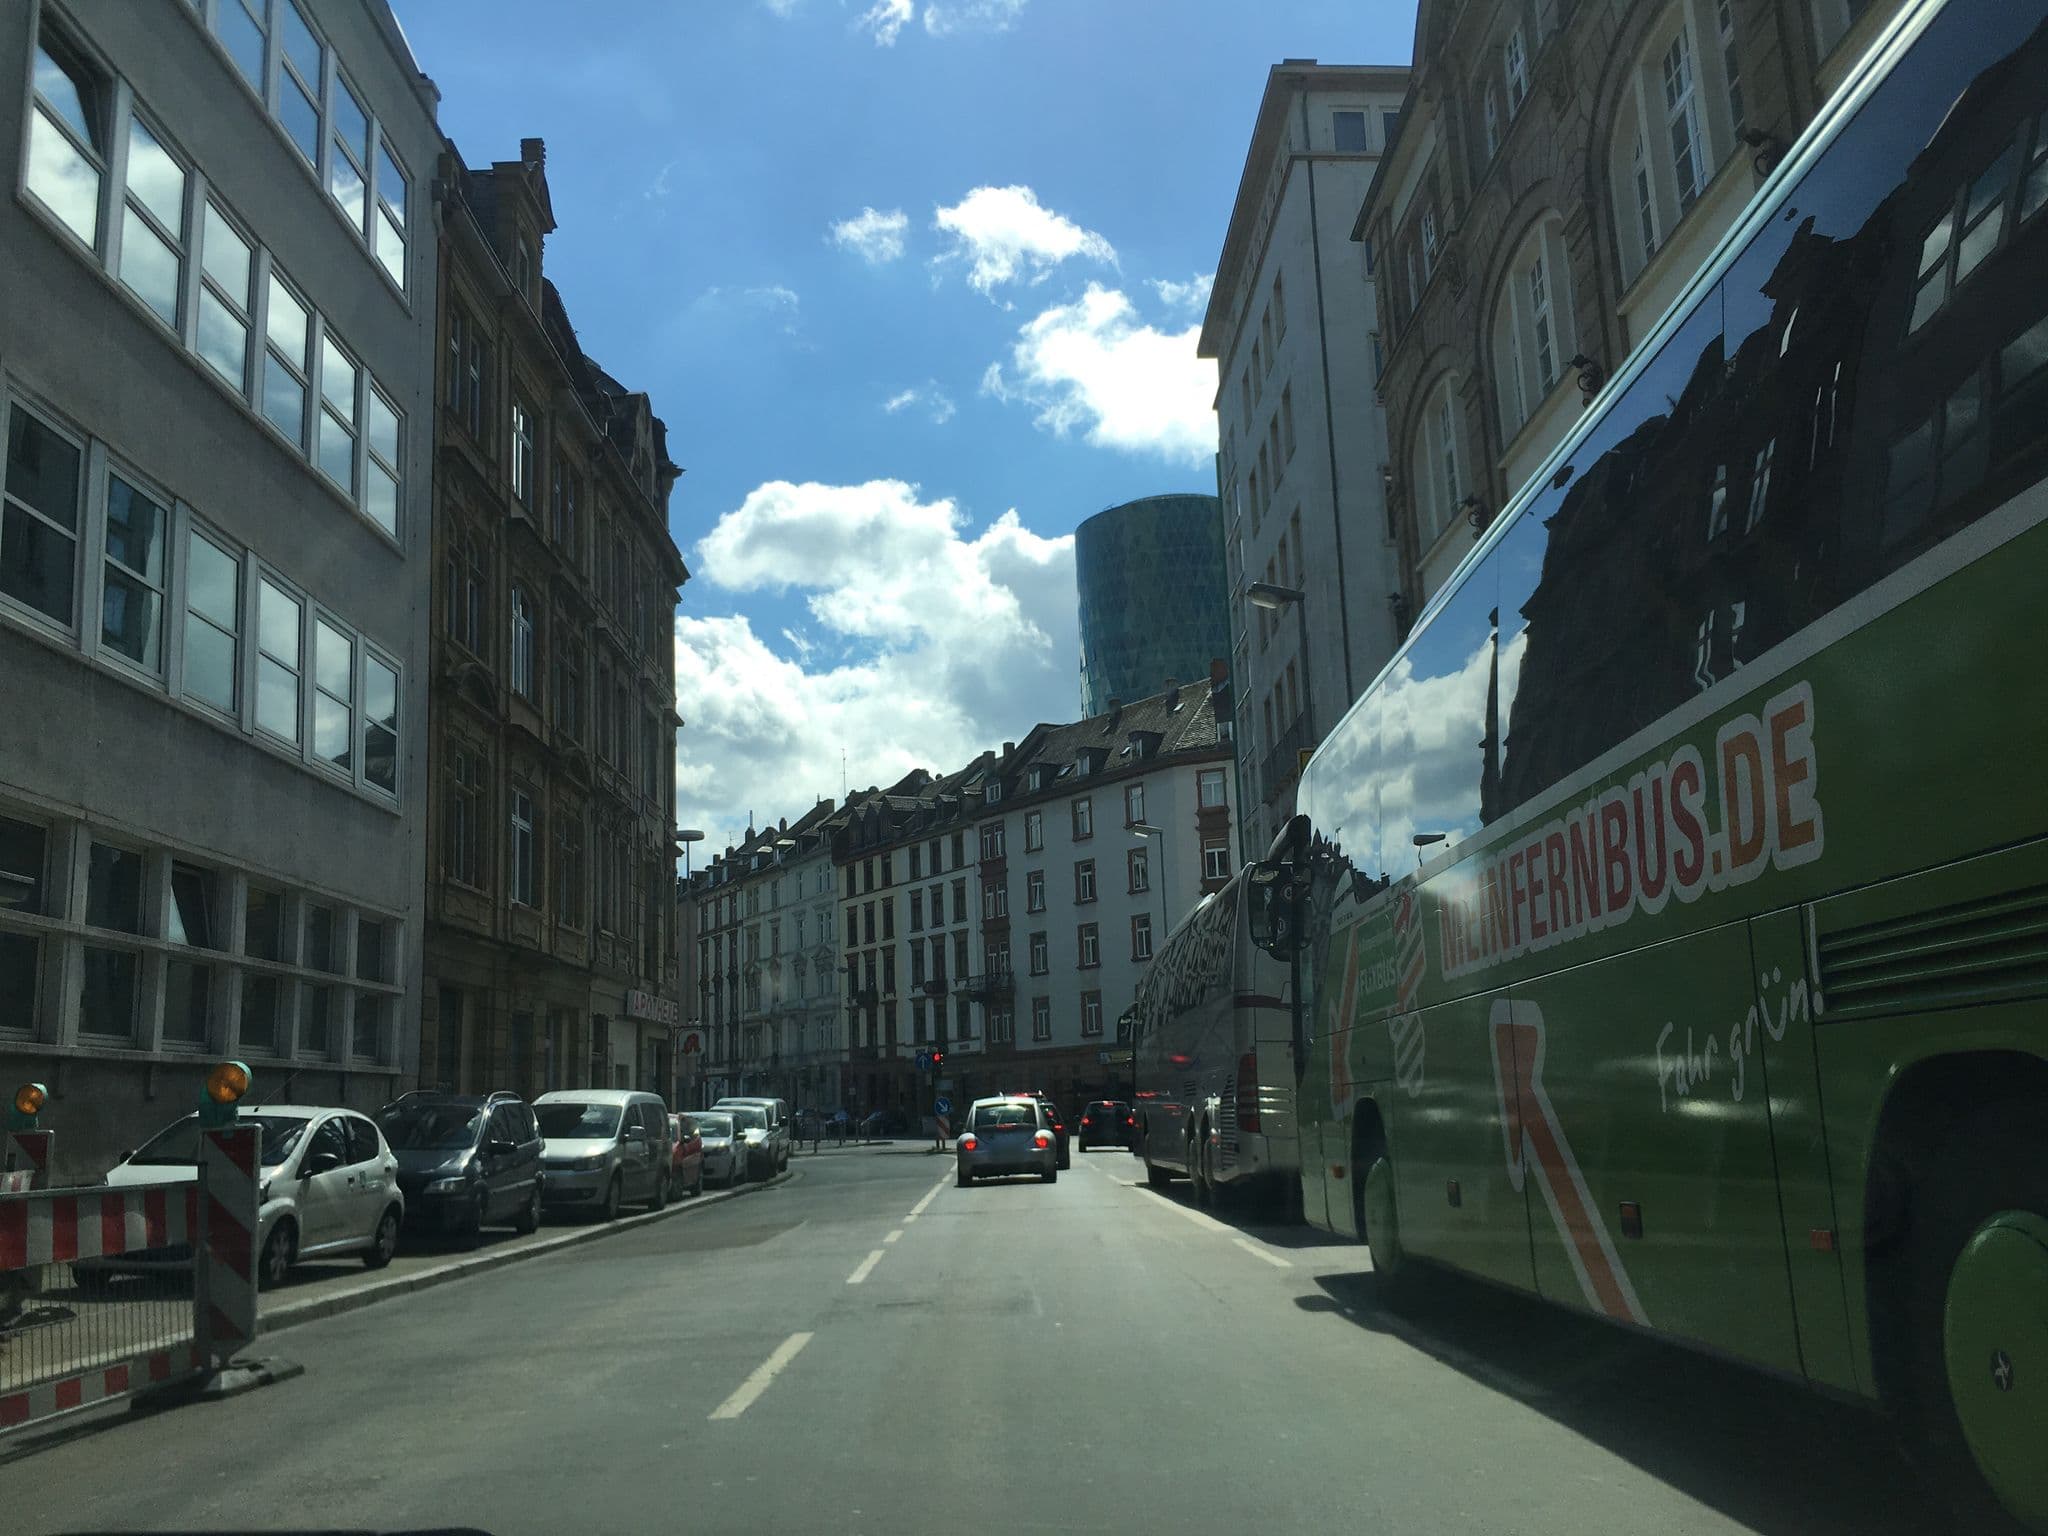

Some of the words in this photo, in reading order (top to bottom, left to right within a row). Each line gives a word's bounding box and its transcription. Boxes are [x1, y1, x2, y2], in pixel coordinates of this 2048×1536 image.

[1439, 692, 1818, 974] MEINFERNBUS.DE
[1656, 1021, 1718, 1113] Fahr
[1729, 904, 1824, 1102] grün!
